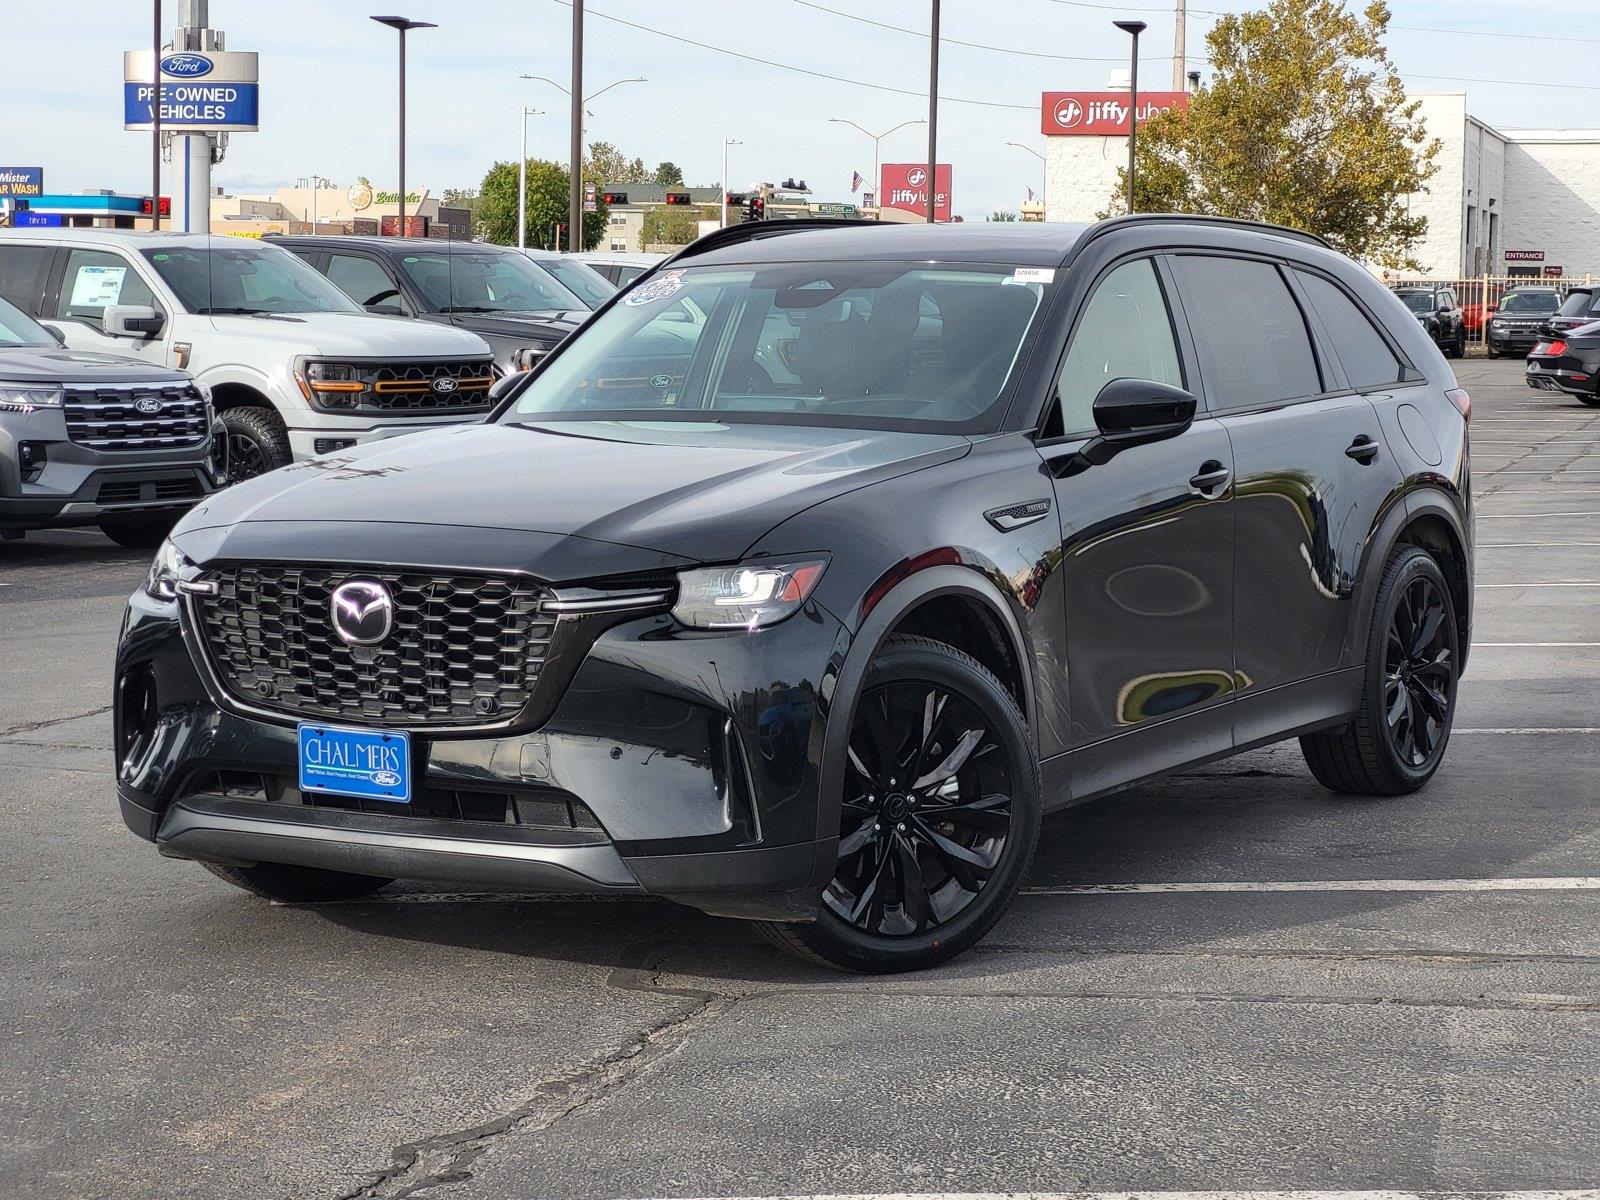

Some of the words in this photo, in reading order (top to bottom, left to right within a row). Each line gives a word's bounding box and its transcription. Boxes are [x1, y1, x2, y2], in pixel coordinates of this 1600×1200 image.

[169, 57, 200, 72] Ford
[1086, 101, 1130, 125] jiffy
[0, 170, 30, 183] Mister
[11, 183, 38, 194] WASH
[890, 189, 918, 205] jiffy
[918, 190, 945, 203] lue
[437, 379, 454, 390] Ford
[655, 376, 669, 386] Ford
[140, 399, 158, 411] Ford
[305, 738, 399, 772] CHALMERS
[375, 772, 396, 785] Ford
